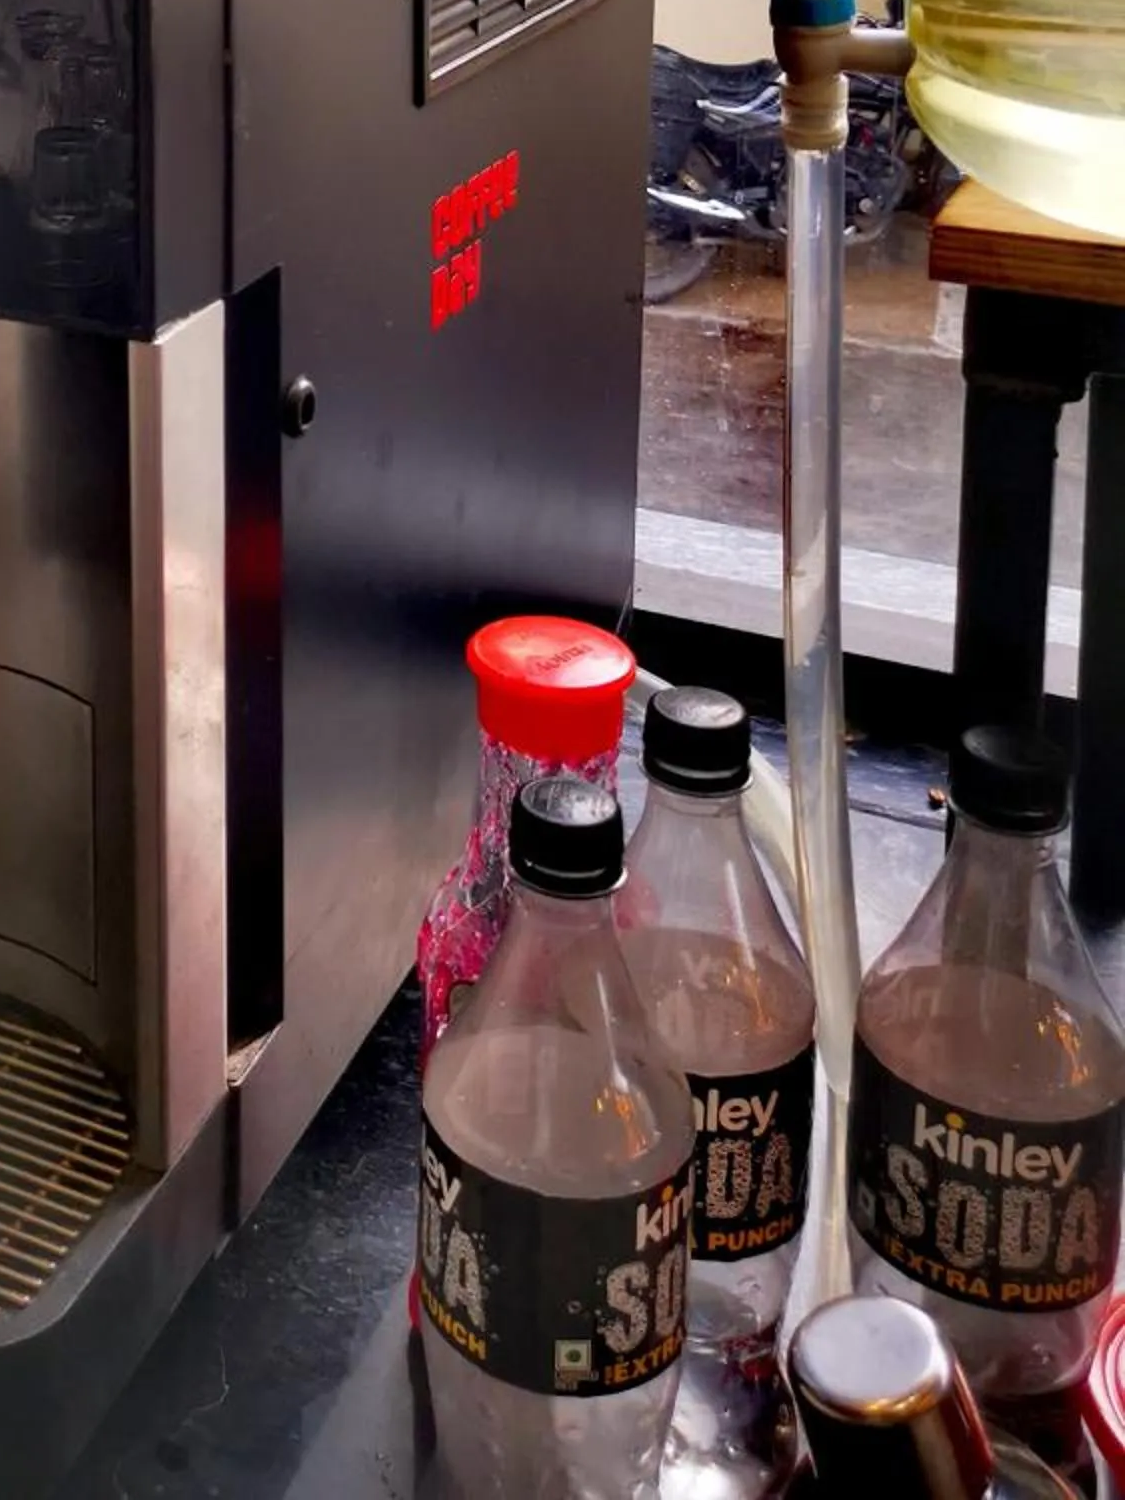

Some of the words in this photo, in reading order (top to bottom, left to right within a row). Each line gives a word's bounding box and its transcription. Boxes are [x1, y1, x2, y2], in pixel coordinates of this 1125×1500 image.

[705, 1132, 795, 1219] DA
[914, 1103, 1083, 1188] kinley
[707, 1212, 794, 1251] PUNCH
[881, 1144, 1101, 1275] SODA
[887, 1237, 990, 1299] EXTRA
[999, 1274, 1098, 1304] PUNCH
